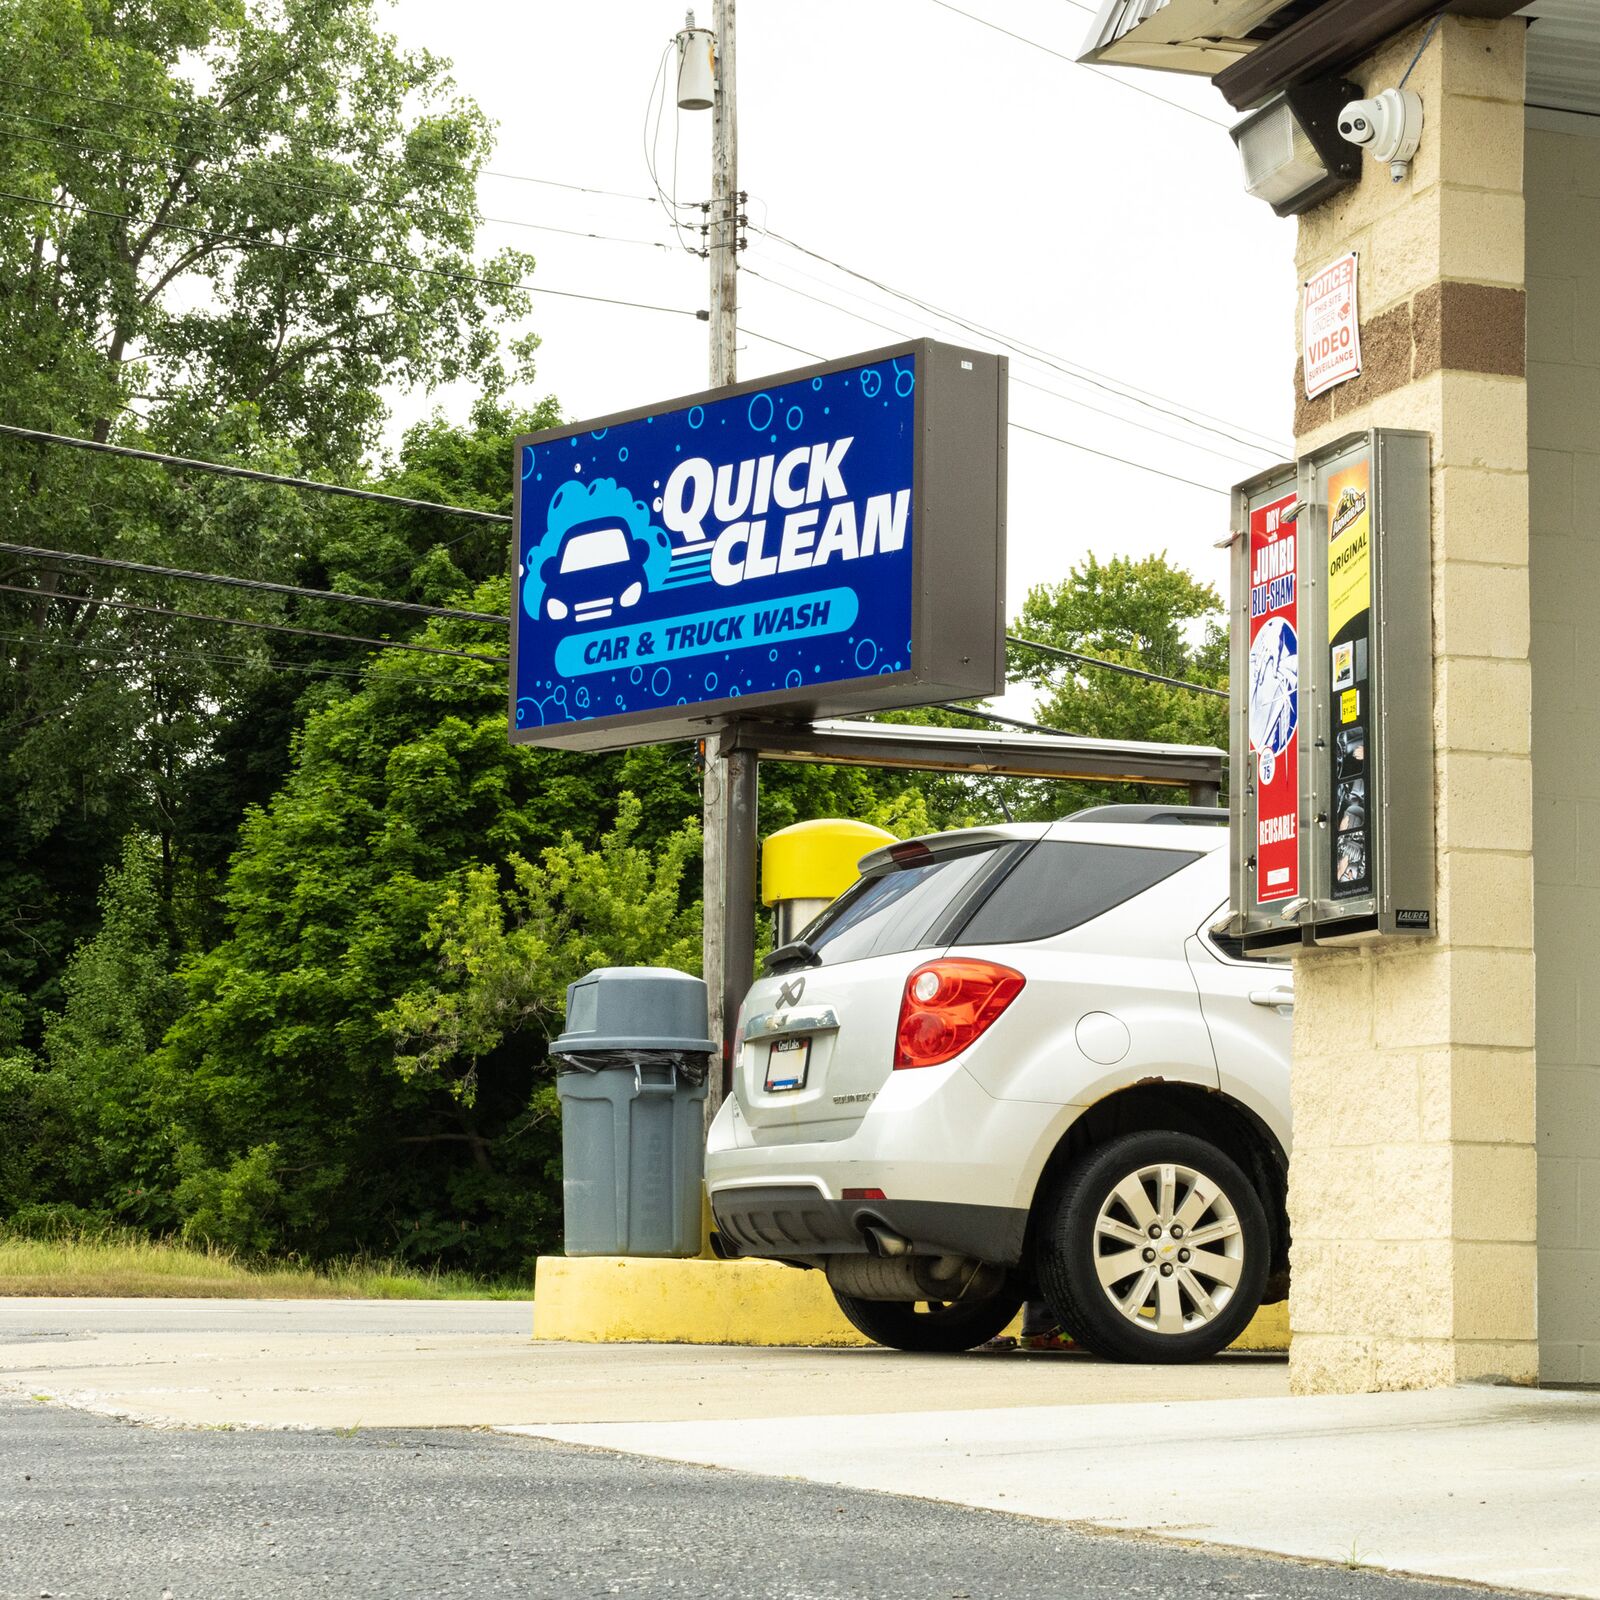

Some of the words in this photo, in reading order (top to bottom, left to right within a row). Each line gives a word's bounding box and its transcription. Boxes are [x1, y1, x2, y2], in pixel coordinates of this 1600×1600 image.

[1308, 325, 1350, 365] VIDEO
[1308, 349, 1354, 381] SURVEILLANCE
[662, 436, 854, 542] QUICK
[710, 489, 910, 586] CLEAN
[1266, 507, 1281, 533] DRY
[1253, 535, 1295, 585] JUMBO
[1330, 531, 1368, 577] ORIGINAL
[1251, 573, 1295, 617] BLU-SHAM
[583, 636, 628, 666] CAR
[636, 630, 655, 657] &
[665, 612, 744, 651] TRUCK
[752, 600, 830, 637] WASH
[1259, 813, 1296, 846] REUSABLE
[1397, 911, 1429, 922] LAUREL
